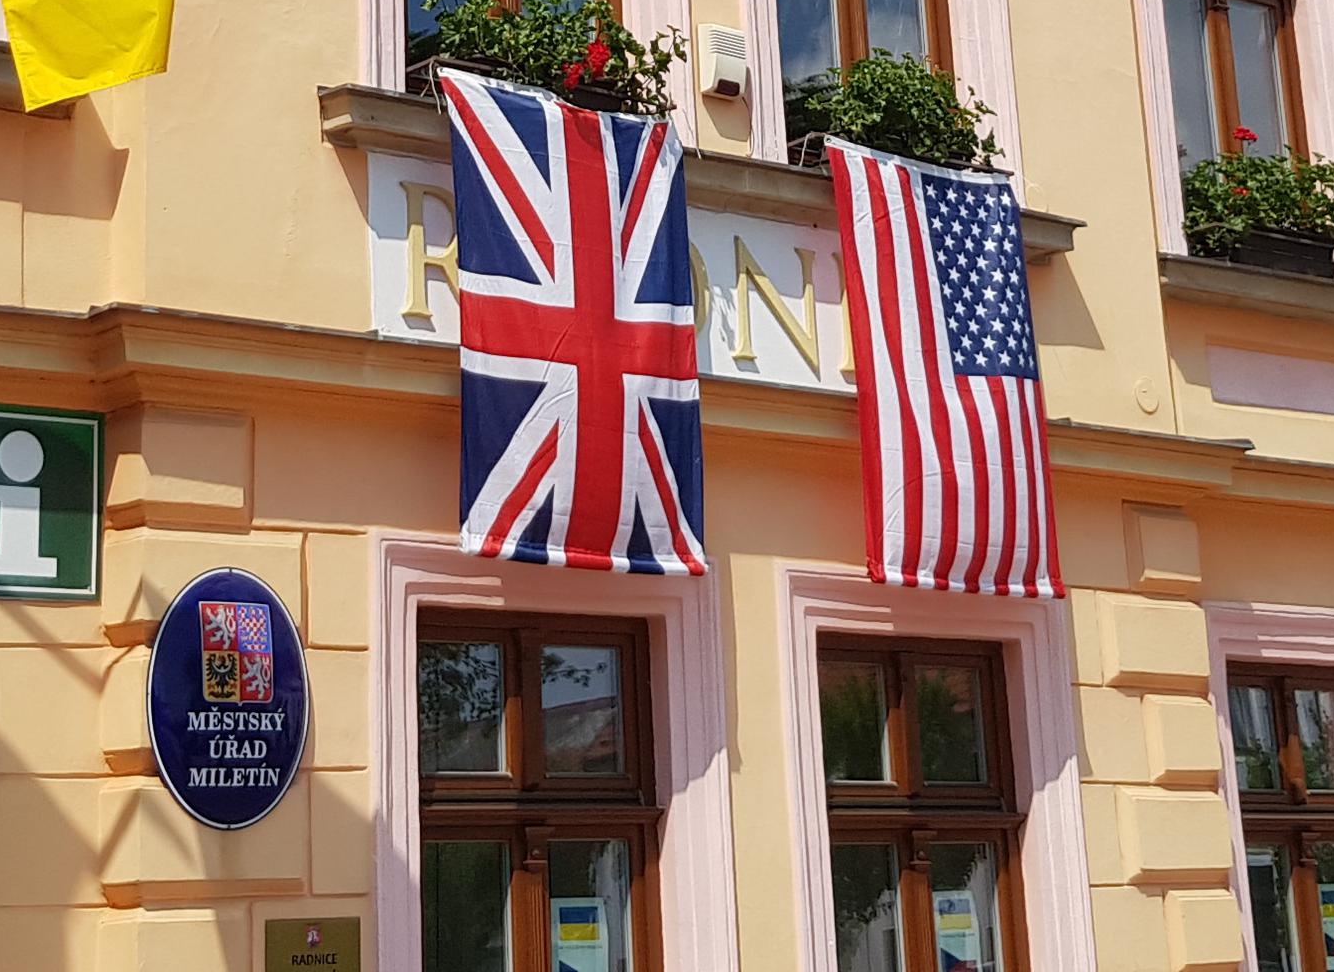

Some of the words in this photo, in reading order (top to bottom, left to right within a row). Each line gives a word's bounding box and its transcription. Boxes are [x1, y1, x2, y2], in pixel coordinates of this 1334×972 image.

[187, 706, 286, 731] MĚSTSKÝ
[209, 734, 268, 759] ÚŘAD
[188, 762, 281, 787] MILETÍN
[291, 953, 338, 966] RADNICE
